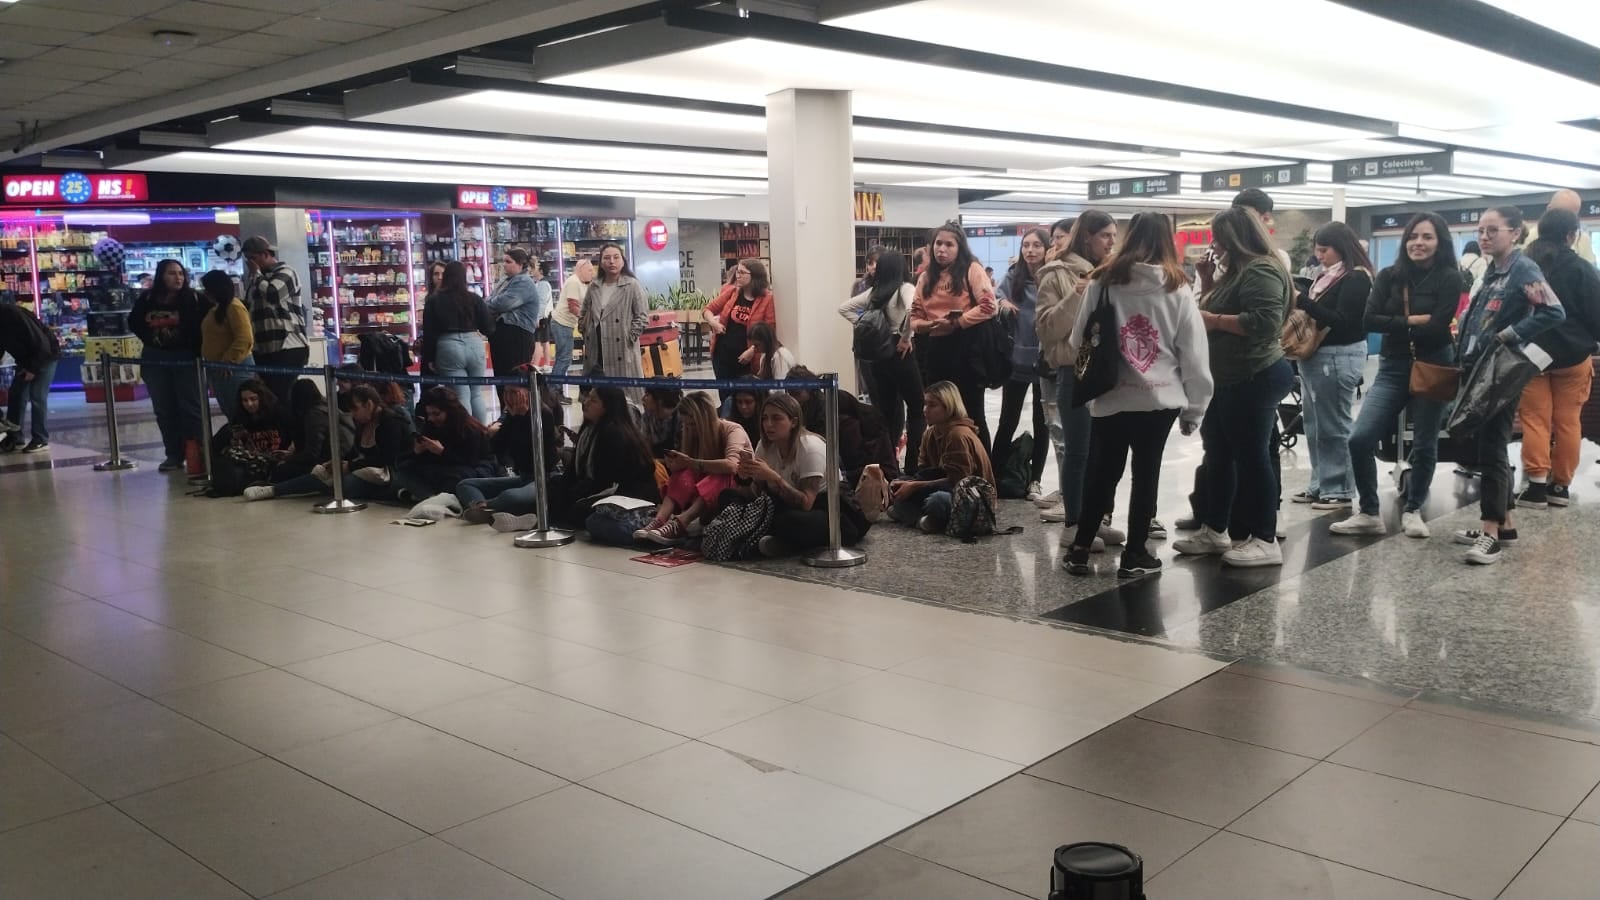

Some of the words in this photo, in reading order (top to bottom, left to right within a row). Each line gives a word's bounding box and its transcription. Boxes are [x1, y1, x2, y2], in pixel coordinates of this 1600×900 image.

[1382, 159, 1425, 170] Colectivos
[6, 180, 55, 197] OPEN
[66, 181, 83, 194] 25
[461, 190, 490, 205] OPEN
[681, 280, 695, 294] DO
